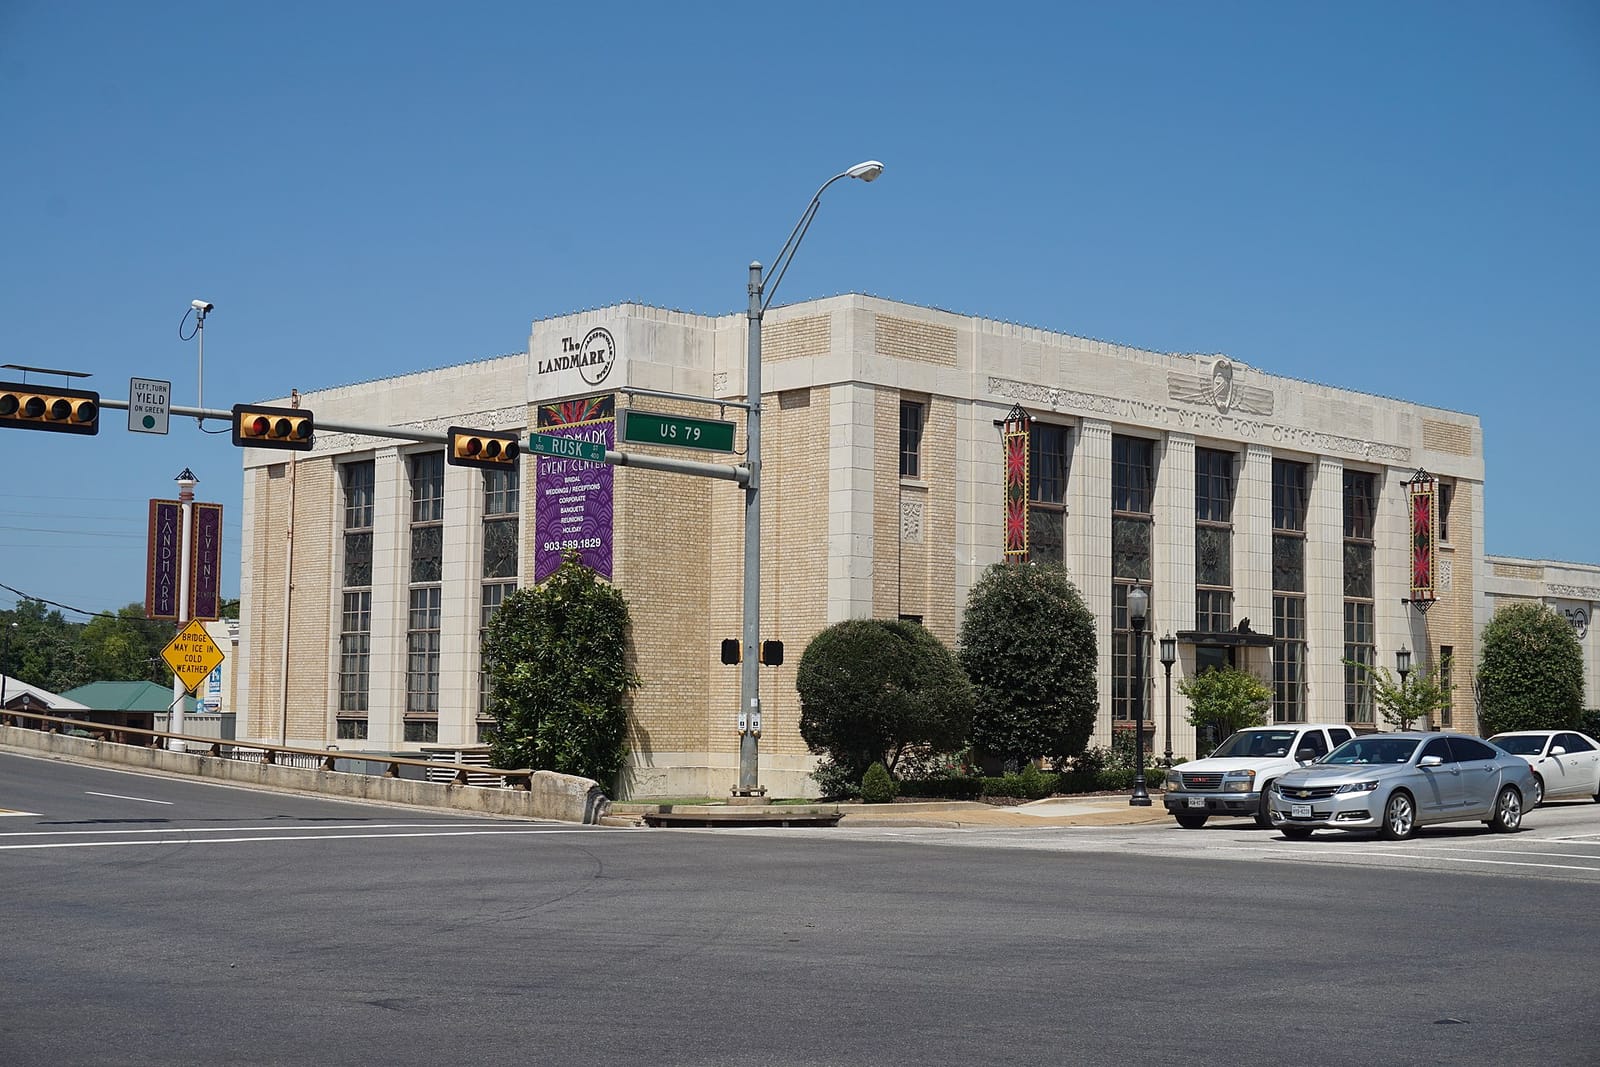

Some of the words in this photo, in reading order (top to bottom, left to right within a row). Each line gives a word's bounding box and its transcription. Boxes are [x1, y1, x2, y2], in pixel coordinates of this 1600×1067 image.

[562, 337, 580, 352] The
[538, 349, 605, 374] LANDMARK
[152, 385, 167, 393] TURN
[136, 392, 165, 405] YIELD
[134, 404, 143, 412] ON
[145, 406, 165, 414] GREEN
[1118, 399, 1168, 424] UNITED
[1232, 417, 1265, 441] POST
[1272, 425, 1317, 448] OFFICE
[660, 423, 677, 438] US
[685, 426, 701, 441] 79
[552, 438, 583, 457] RUSK
[541, 461, 567, 476] EVENT
[545, 486, 569, 496] WEDDINGS
[572, 483, 601, 492] RECEPTIONS
[558, 495, 586, 504] CORPORATE
[560, 505, 585, 514] BANQUETS
[560, 515, 584, 524] REUNIONS
[562, 526, 581, 534] HOLIDAY
[544, 538, 601, 551] 903.589.1829
[160, 508, 172, 612] LANDMARK
[203, 525, 212, 589] EVENT
[182, 633, 207, 643] BRIDGE
[174, 643, 188, 652] MAY
[192, 645, 203, 653] ICE
[184, 654, 203, 663] COLD
[176, 664, 208, 674] WEATHER
